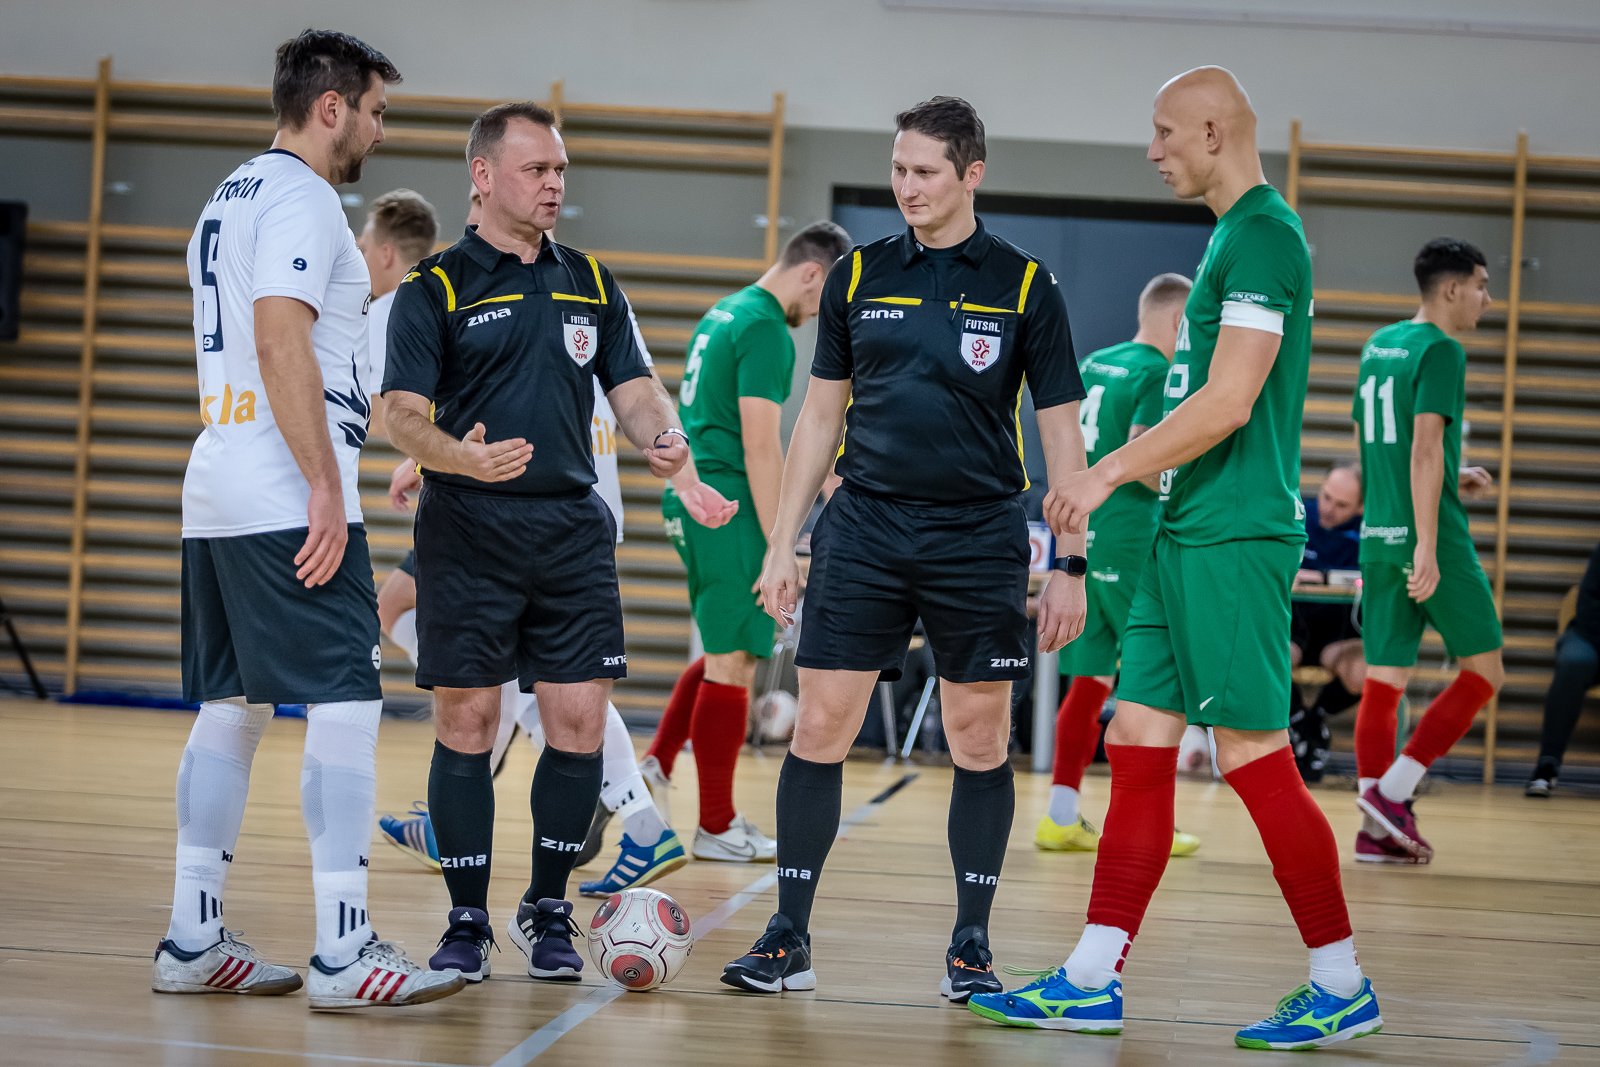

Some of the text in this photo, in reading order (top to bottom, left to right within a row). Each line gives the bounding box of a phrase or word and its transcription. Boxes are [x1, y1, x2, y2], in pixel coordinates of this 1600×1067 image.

[467, 307, 512, 327] zina
[570, 315, 590, 326] FUTSAL
[860, 309, 904, 320] zina
[965, 318, 1001, 333] FUTSAL
[680, 333, 711, 407] 5
[971, 359, 987, 367] PZPN
[200, 383, 256, 425] kla
[1360, 375, 1397, 444] 11
[1080, 384, 1105, 452] 4
[990, 656, 1029, 667] zina
[540, 836, 586, 852] zin
[440, 854, 487, 868] zina
[965, 872, 1000, 886] zin
